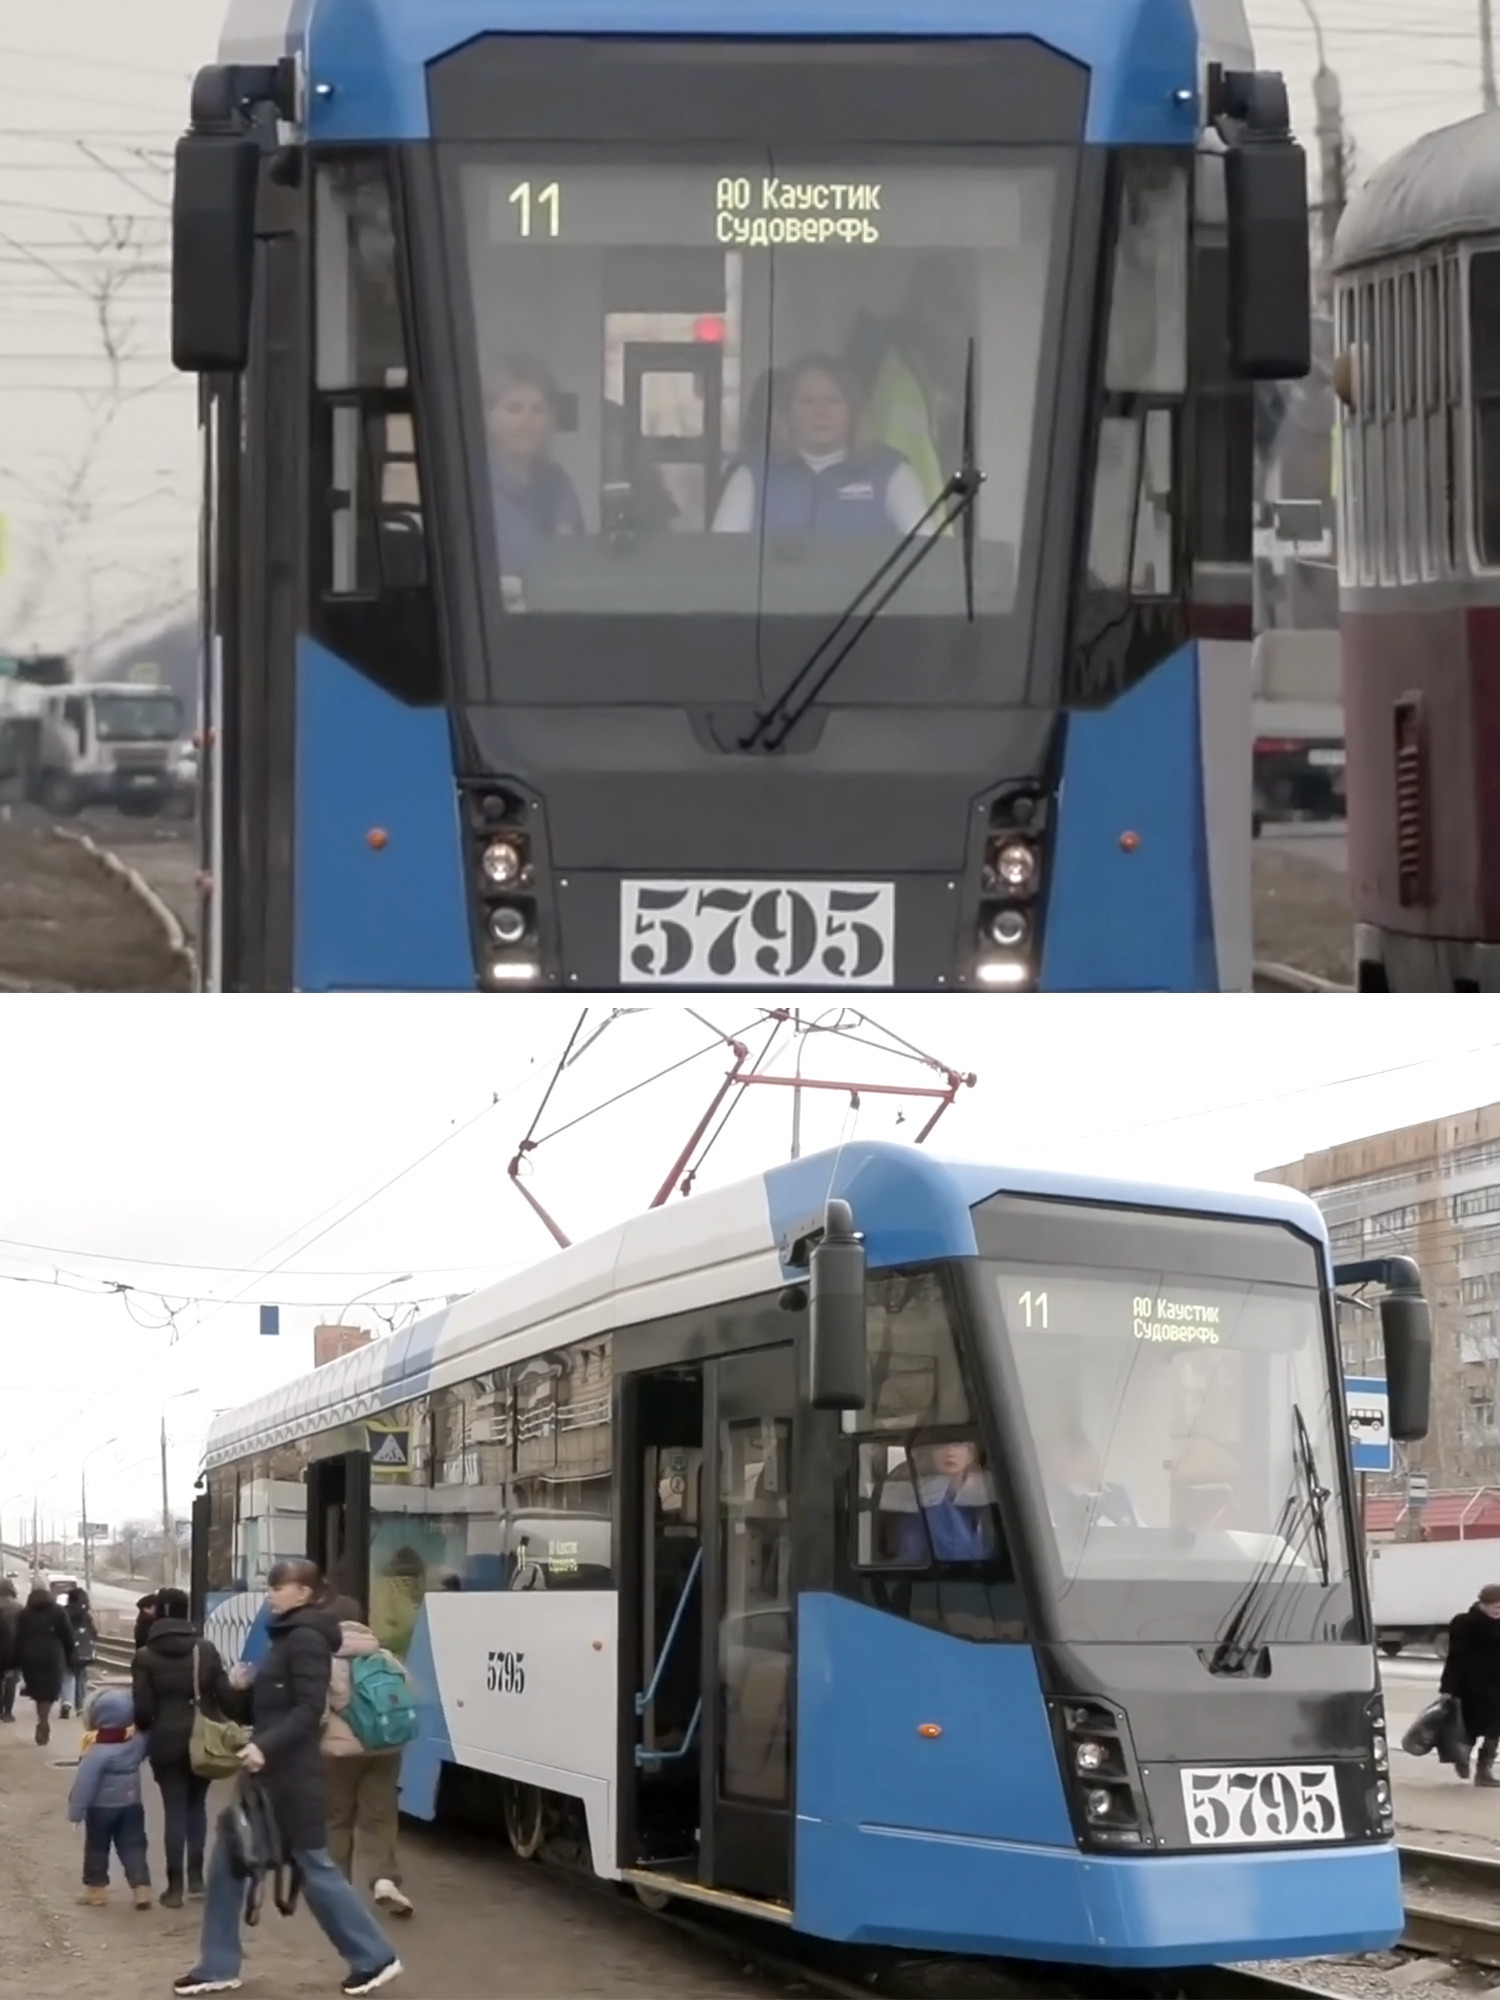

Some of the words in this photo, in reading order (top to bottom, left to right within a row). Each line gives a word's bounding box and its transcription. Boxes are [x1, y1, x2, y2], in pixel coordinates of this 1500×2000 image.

[508, 182, 560, 237] 11
[716, 177, 750, 209] АО
[762, 177, 881, 210] Каустик
[716, 211, 879, 246] Судоверфь
[630, 887, 885, 978] 5795
[1018, 1290, 1049, 1329] 11
[1133, 1296, 1152, 1318] АО
[1157, 1298, 1220, 1323] Каустик
[1133, 1318, 1220, 1344] Судоверфь
[487, 1652, 525, 1693] 5795
[1191, 1771, 1336, 1839] 5795
